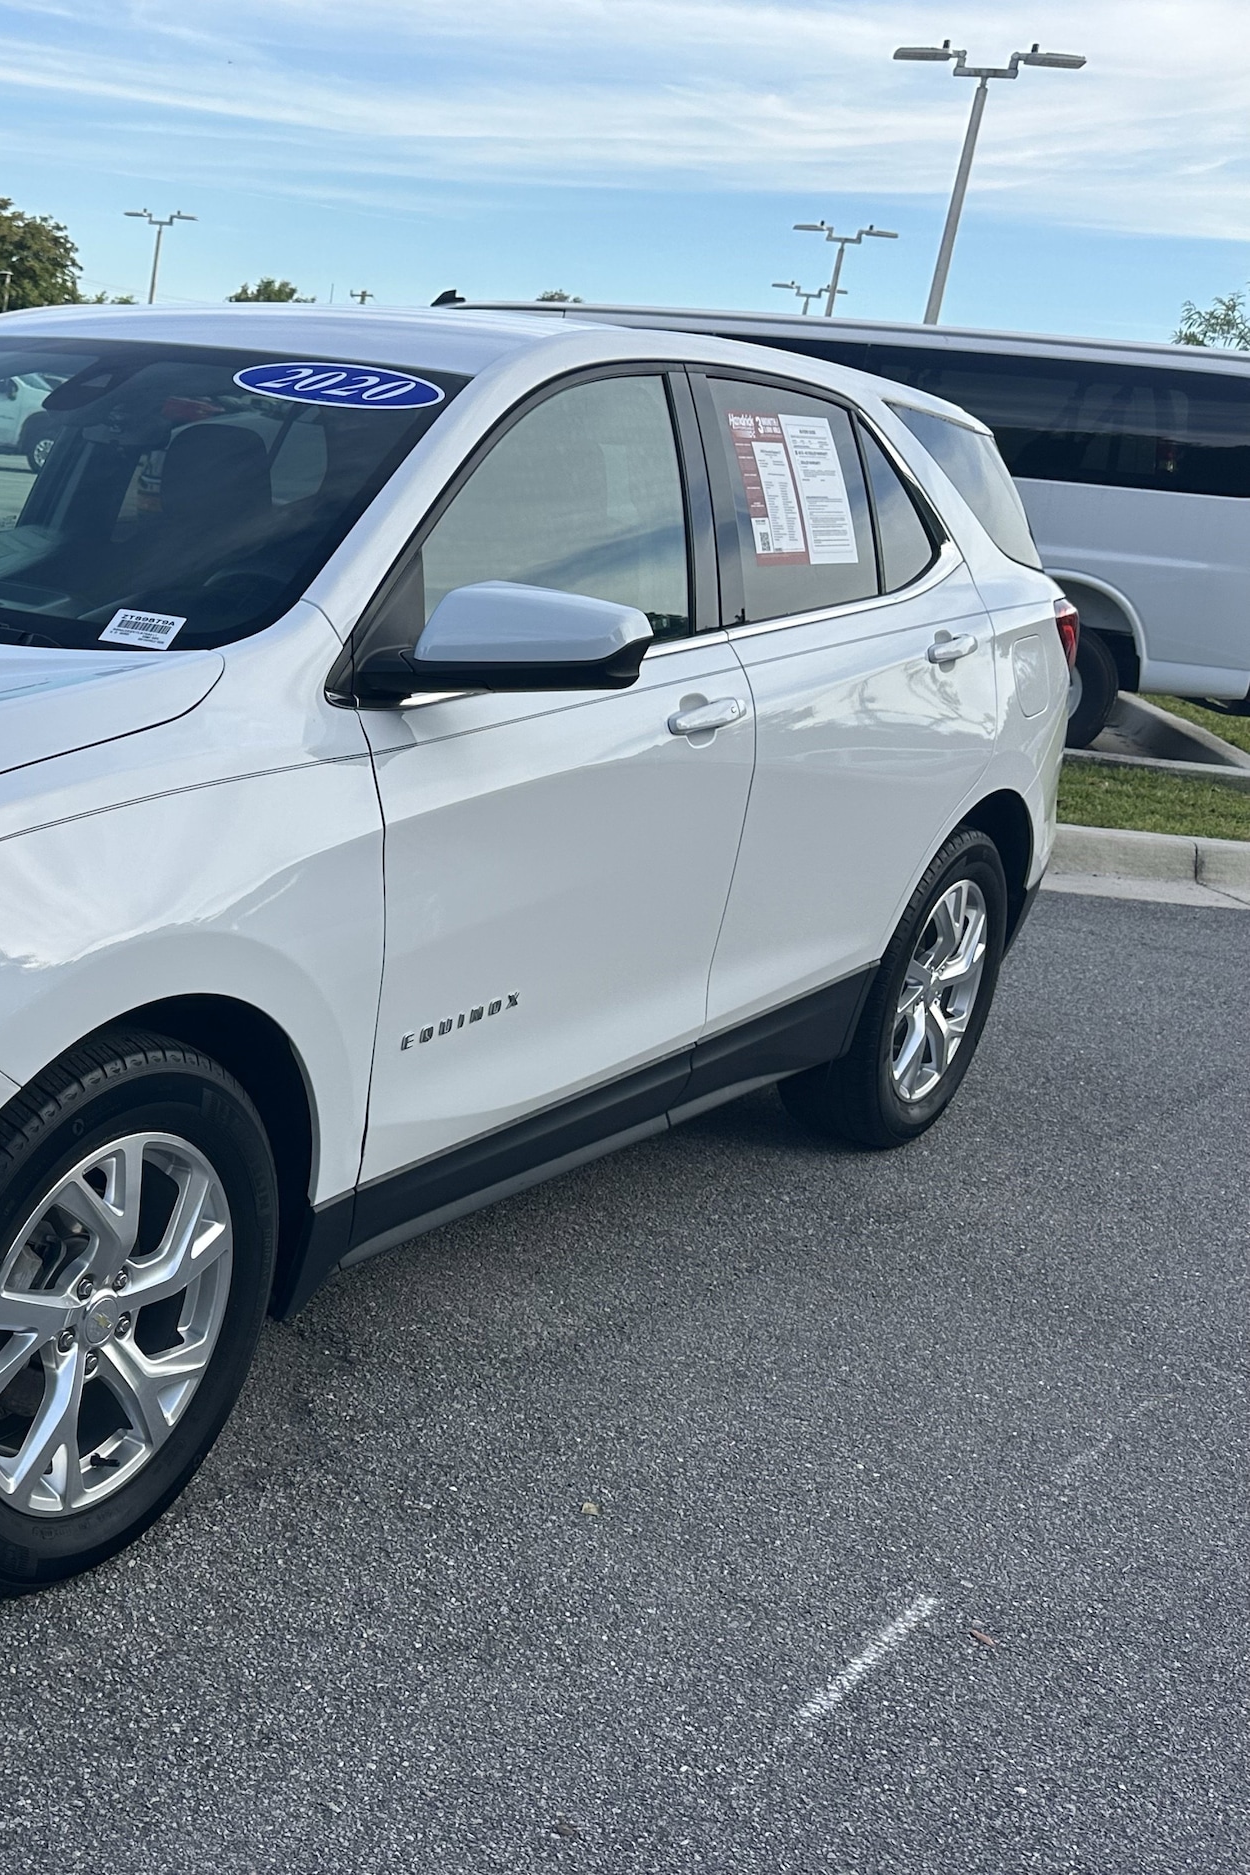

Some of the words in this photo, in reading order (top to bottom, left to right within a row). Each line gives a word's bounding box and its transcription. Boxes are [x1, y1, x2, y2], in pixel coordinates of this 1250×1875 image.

[255, 368, 417, 401] 2020
[755, 416, 764, 434] 3
[400, 990, 520, 1051] EQUINOX
